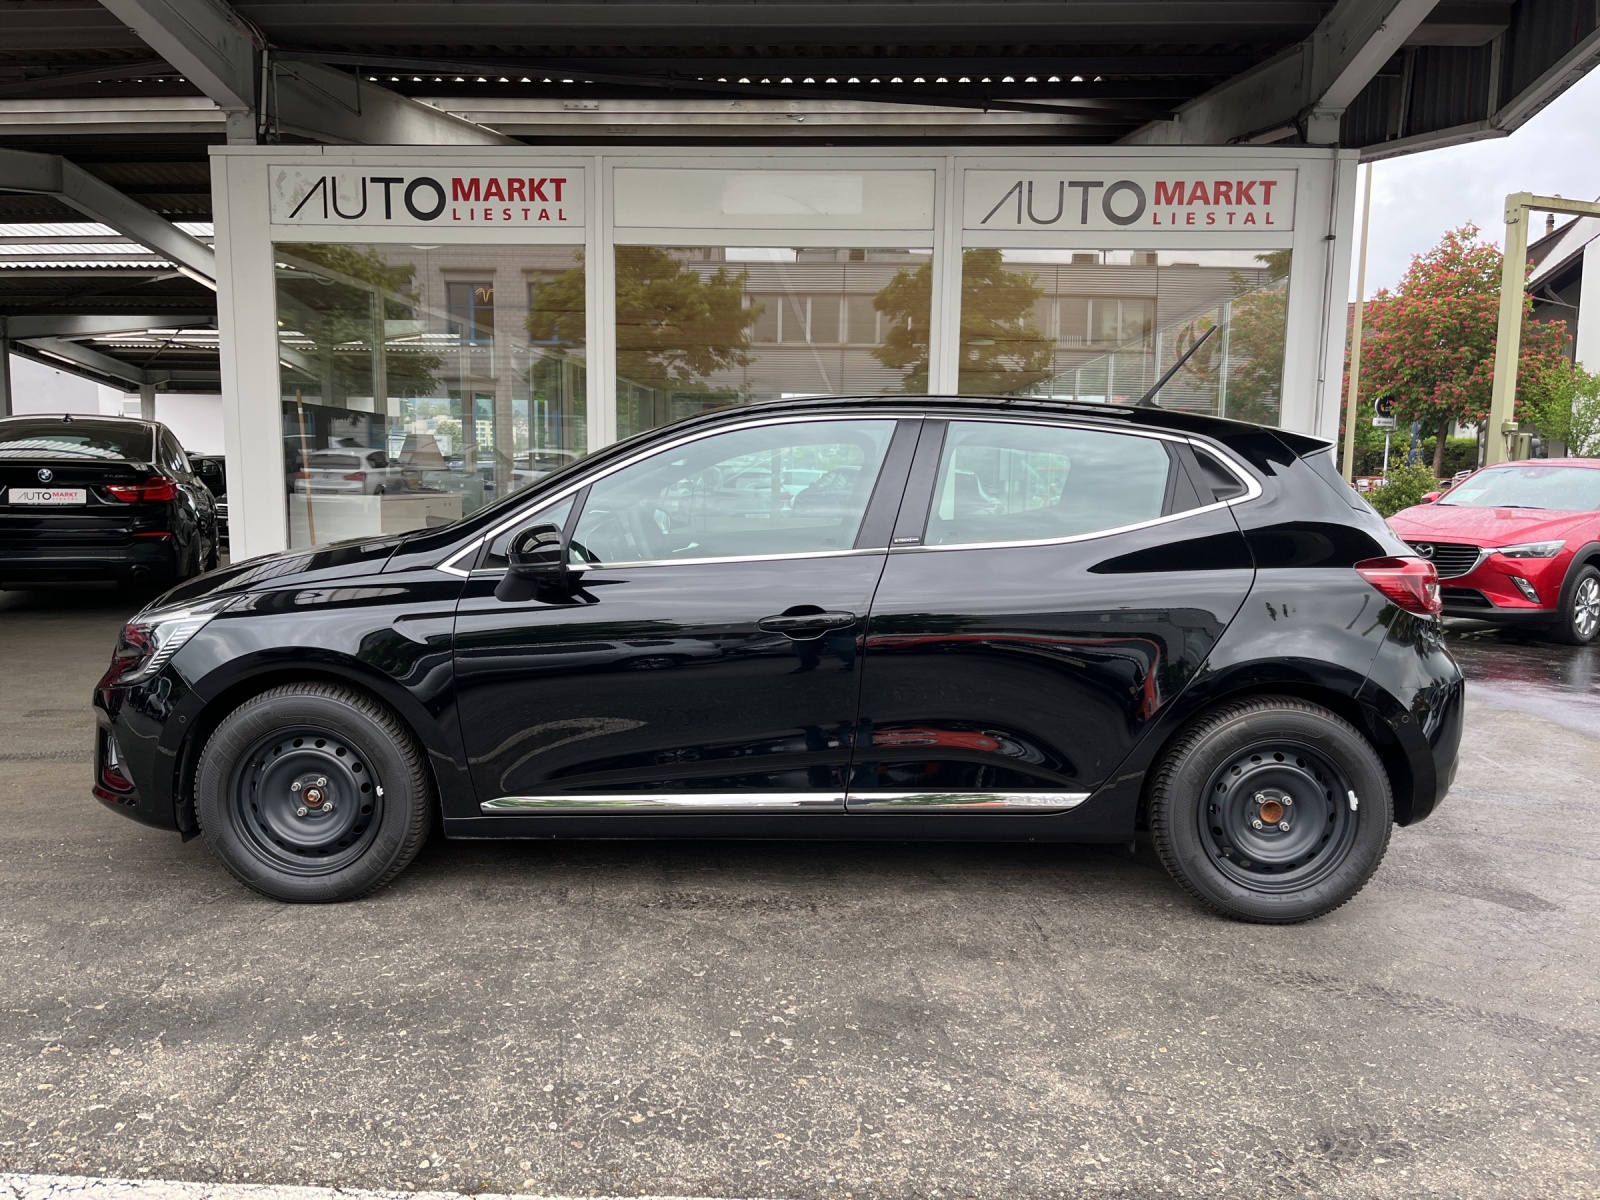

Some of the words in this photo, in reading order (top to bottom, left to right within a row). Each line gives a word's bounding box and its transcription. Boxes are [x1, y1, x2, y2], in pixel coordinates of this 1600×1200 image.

[288, 176, 446, 221] AUTO
[451, 177, 567, 202] MARKT
[980, 180, 1147, 226] AUTO
[1153, 180, 1278, 206] MARKT
[452, 208, 567, 221] LIESTAL
[1152, 212, 1275, 225] LIESTAL
[17, 492, 52, 500] AUTO
